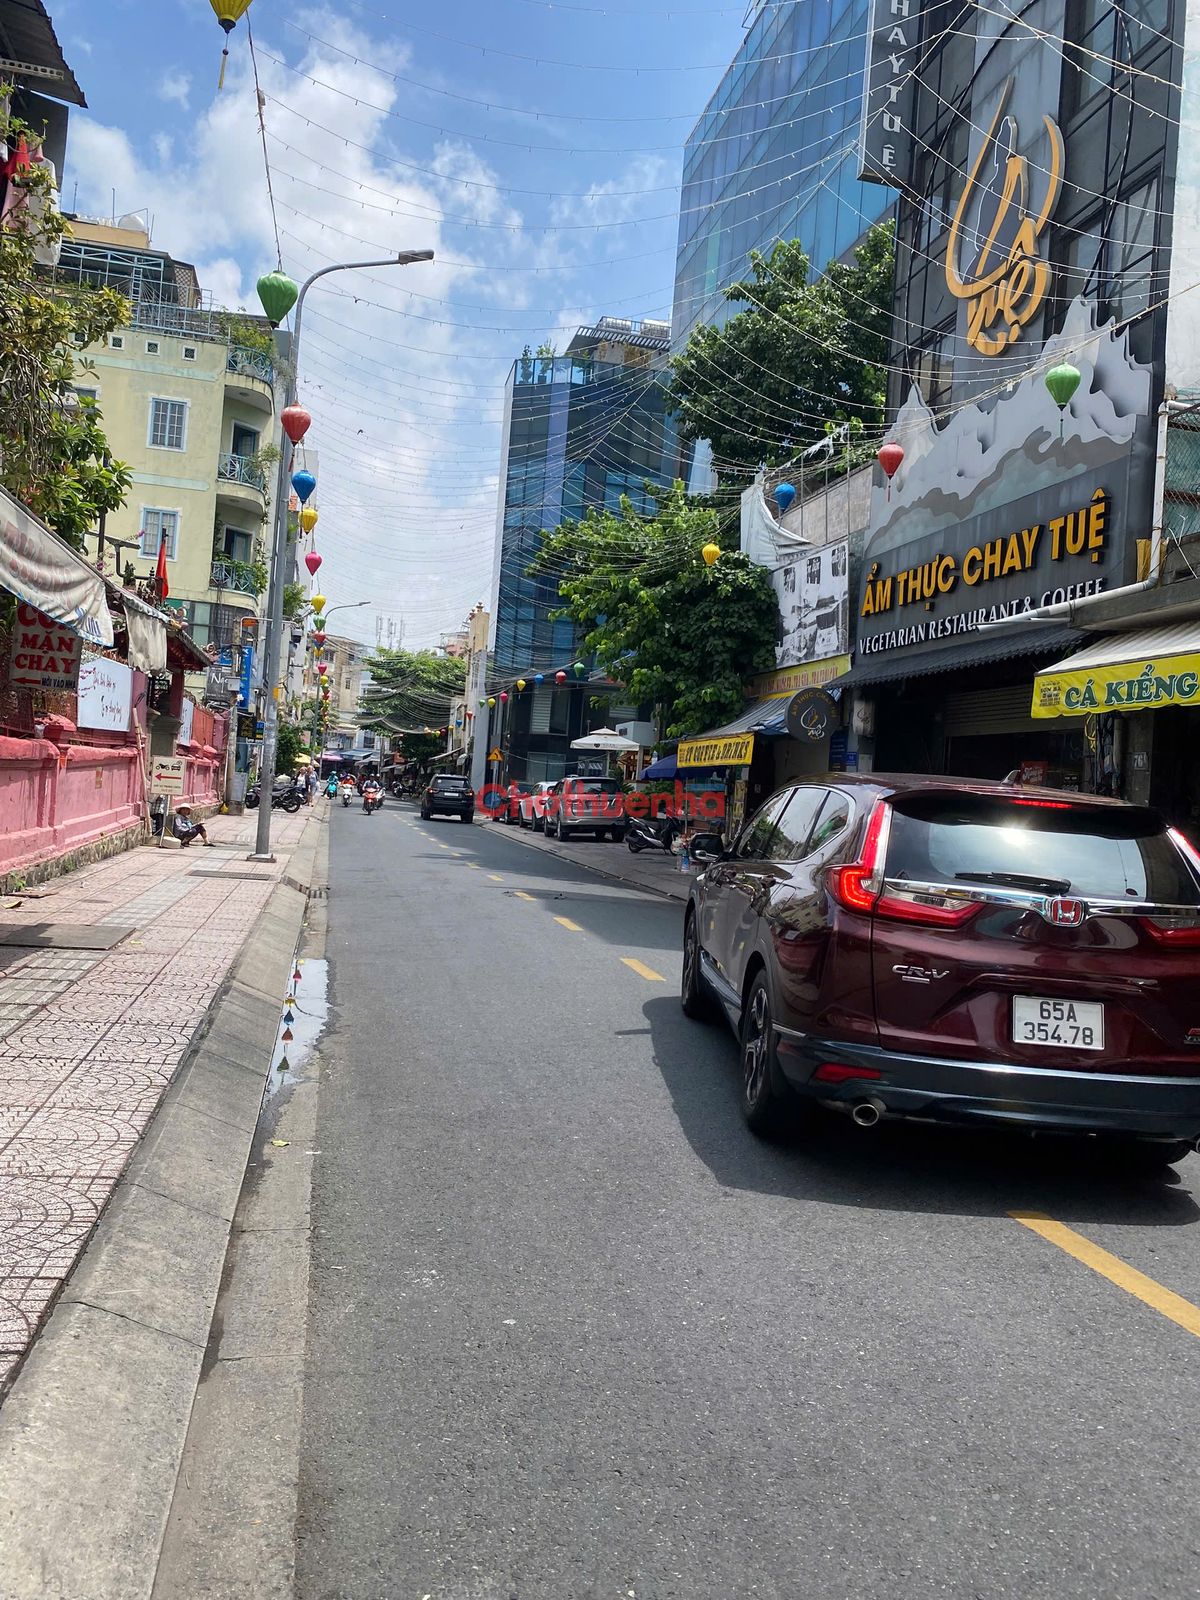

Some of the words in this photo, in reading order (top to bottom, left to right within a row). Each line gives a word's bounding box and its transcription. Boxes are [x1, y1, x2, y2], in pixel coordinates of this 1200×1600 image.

[861, 562, 893, 617] ẨM
[897, 553, 957, 611] THỰC
[962, 525, 1040, 586] CHAY
[1049, 487, 1106, 563] TUỆ
[859, 622, 926, 655] VEGETARIAN
[928, 599, 1020, 640] RESTAURANT
[20, 630, 76, 655] MẶN
[14, 653, 77, 674] CHAY
[1064, 679, 1099, 709] CÁ
[1104, 663, 1198, 706] KIỂNG
[892, 964, 950, 979] CR-V
[1039, 1000, 1077, 1023] 65A
[1023, 1021, 1094, 1046] 354.78
